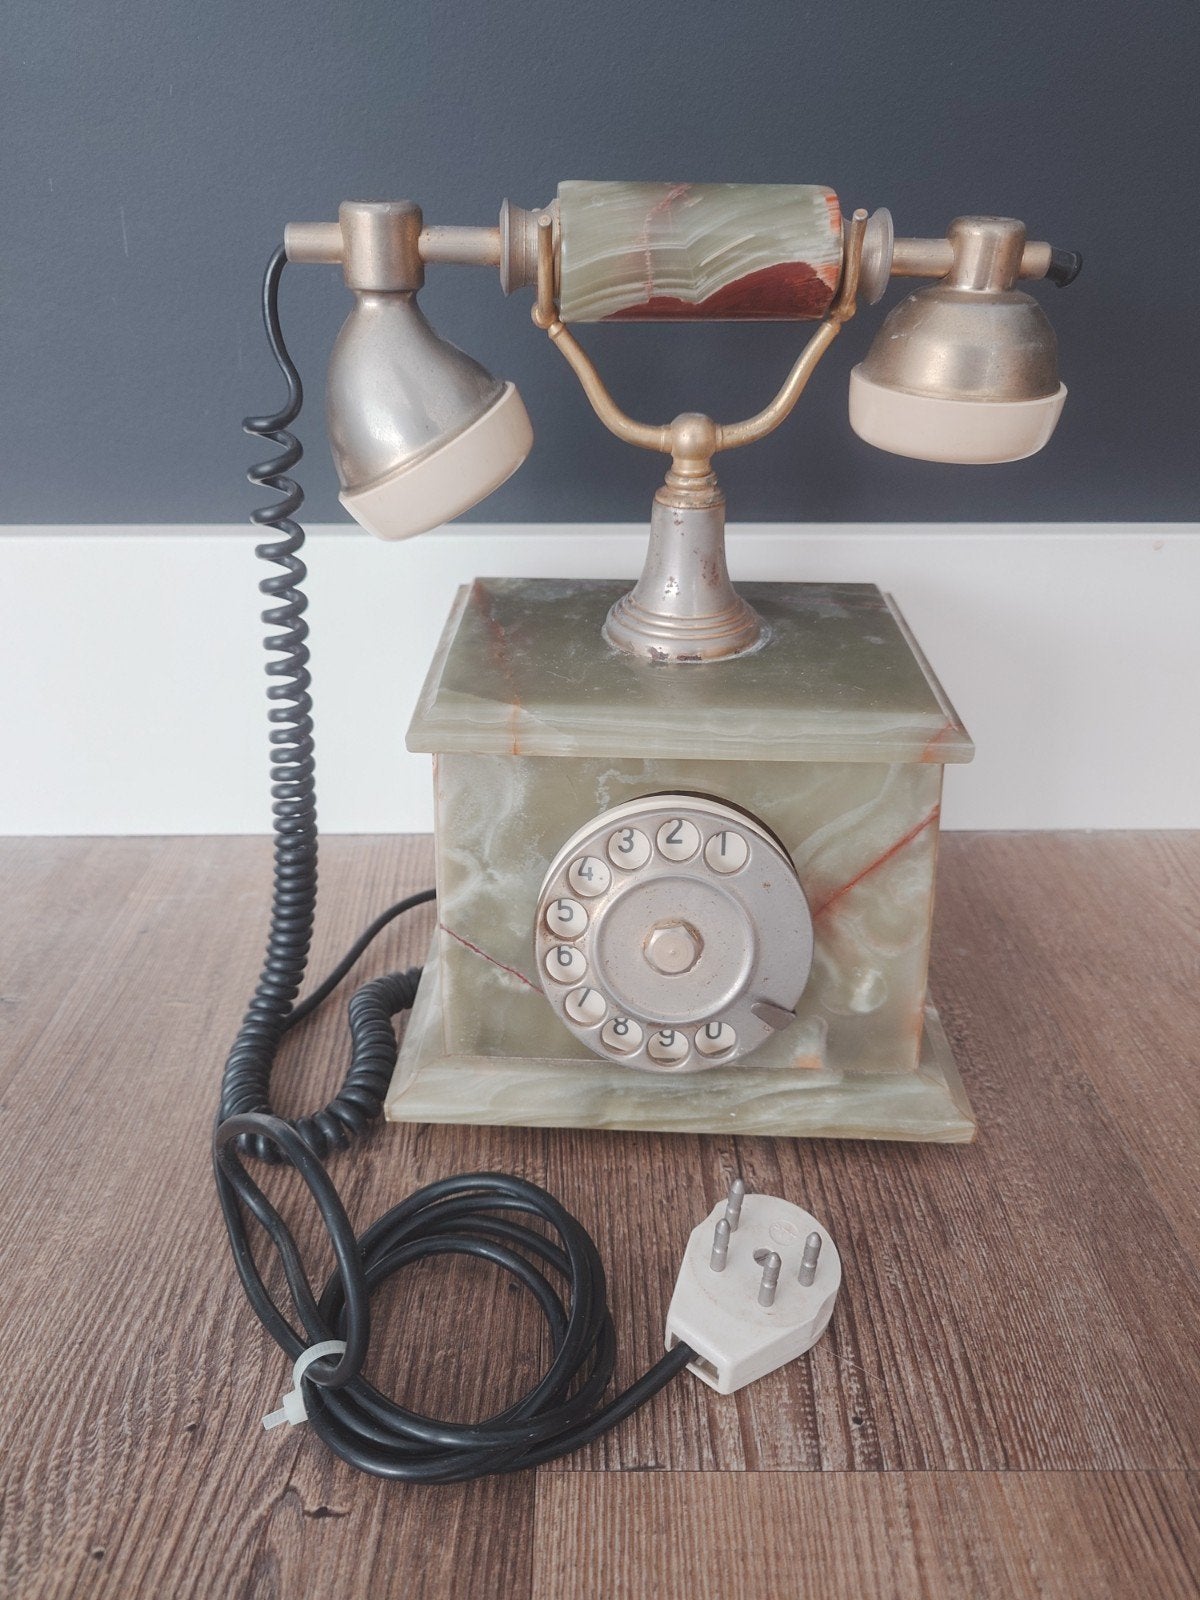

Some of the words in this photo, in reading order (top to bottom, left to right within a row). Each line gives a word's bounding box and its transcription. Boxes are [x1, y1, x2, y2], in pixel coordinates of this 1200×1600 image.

[617, 829, 634, 853] 3
[666, 820, 683, 844] 2
[715, 831, 726, 855] 1
[577, 857, 593, 881] 4
[557, 900, 573, 922] 5
[557, 946, 573, 966] 6
[613, 1018, 629, 1036] 8
[659, 1030, 675, 1046] 9
